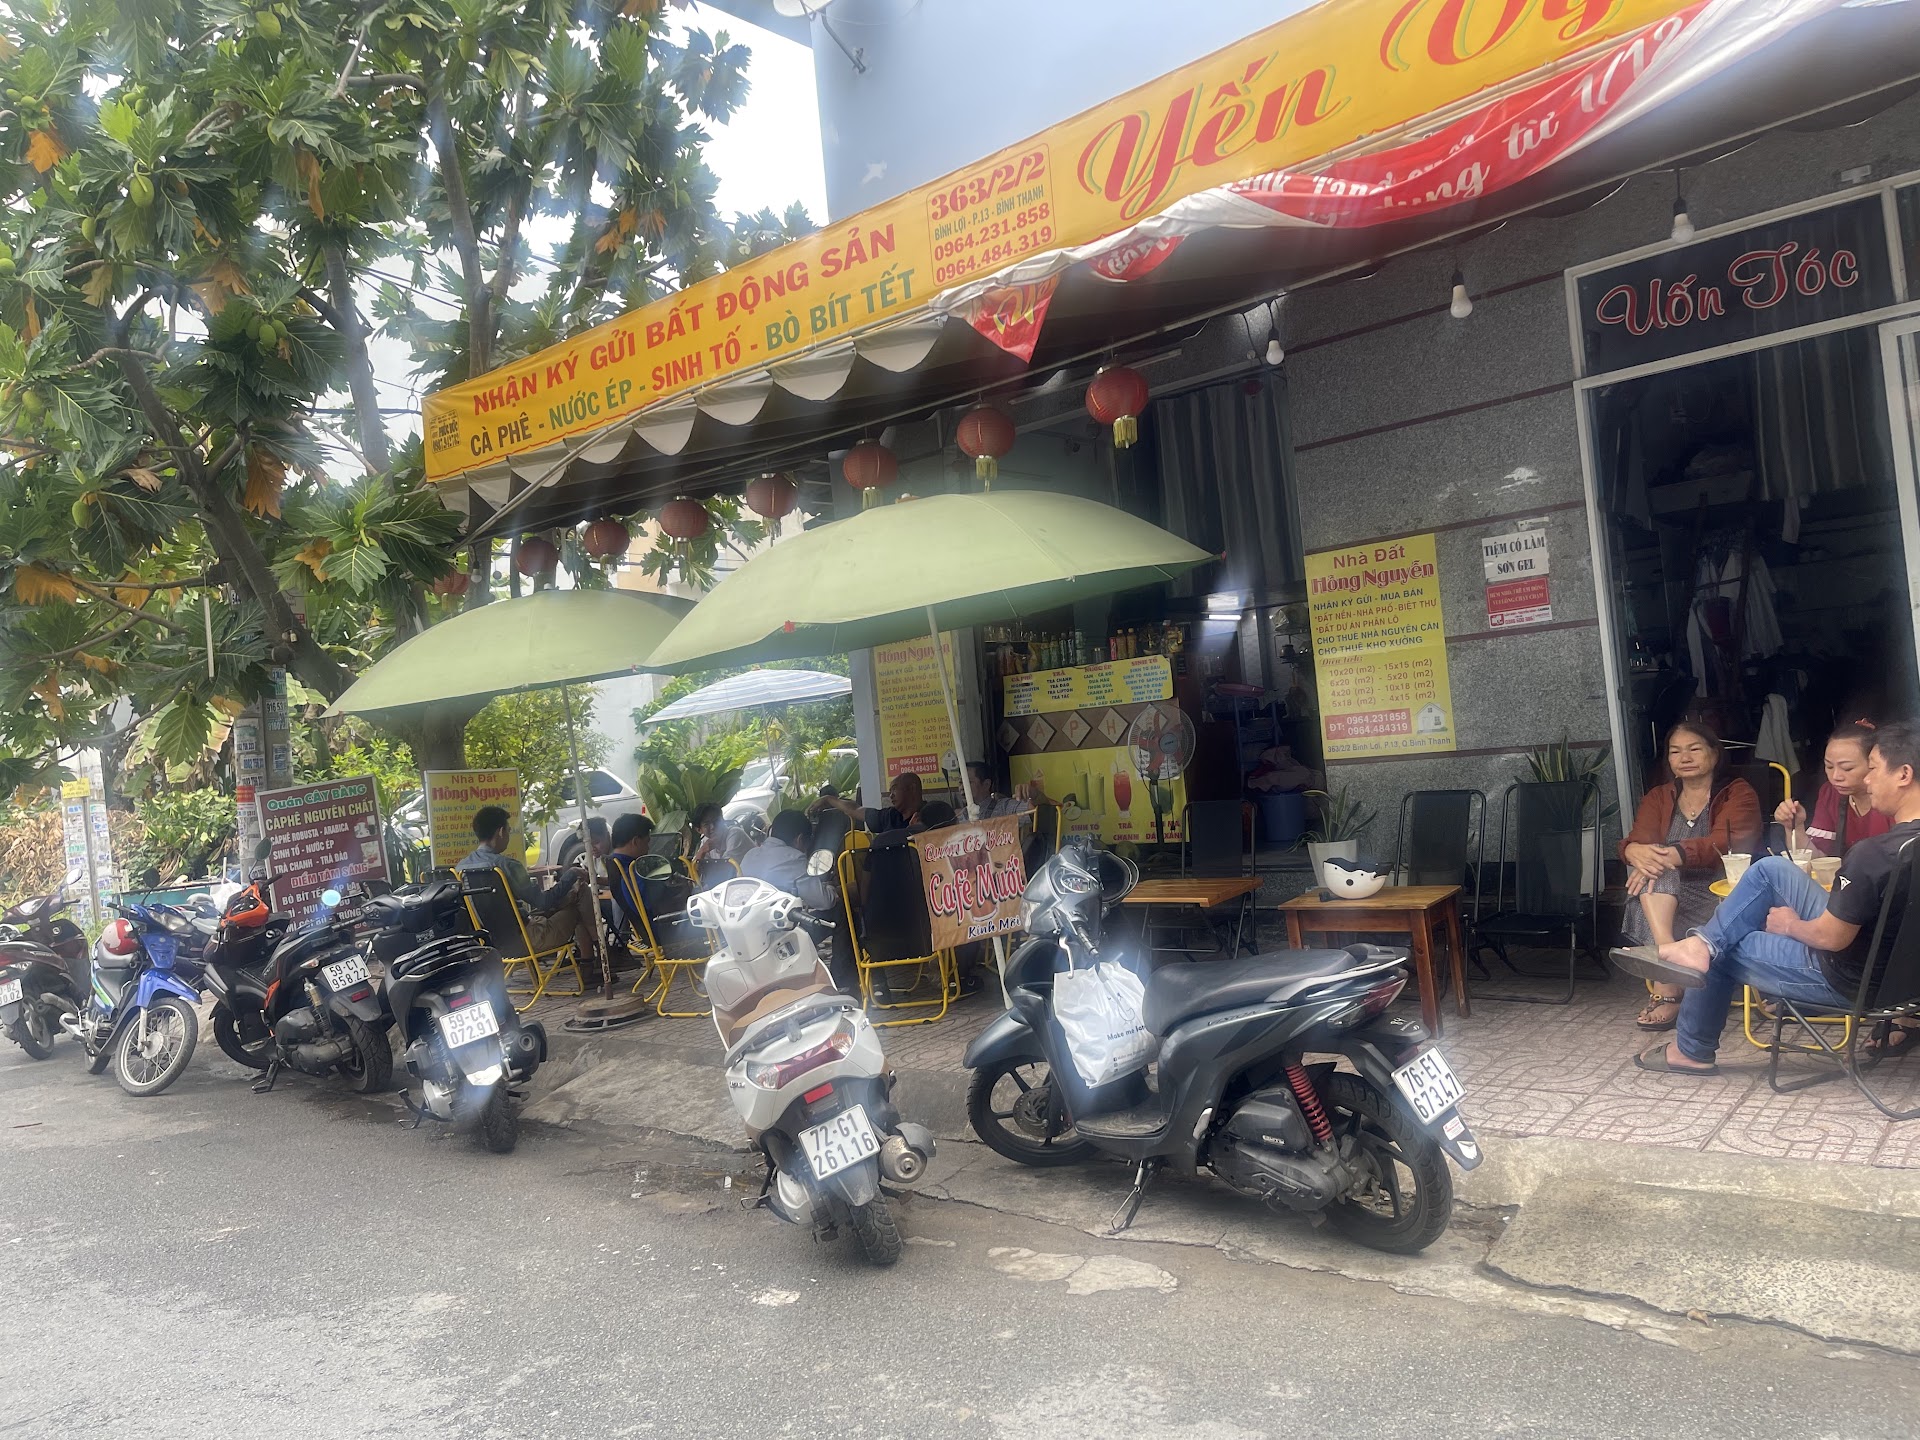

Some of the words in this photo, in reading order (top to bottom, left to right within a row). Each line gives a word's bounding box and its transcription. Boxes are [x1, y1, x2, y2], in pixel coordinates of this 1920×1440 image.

[1077, 50, 1351, 220] Yến
[1502, 111, 1560, 160] từ
[931, 152, 1046, 221] 363/2/2
[934, 222, 952, 241] BÌNH
[953, 216, 967, 236] LỢI
[973, 207, 990, 226] P.13
[996, 195, 1015, 216] BÌNH
[1017, 184, 1044, 208] THẠNH
[934, 202, 1050, 261] 0964.231.858
[936, 225, 1052, 283] 0964.484.319
[1596, 274, 1726, 336] Uốn
[1727, 241, 1859, 309] Tóc
[473, 375, 537, 416] NHẬN
[546, 351, 579, 388] KÝ
[590, 329, 636, 371] GỬI
[646, 300, 704, 350] BẤT
[716, 262, 810, 320] ĐỘNG
[820, 224, 896, 278] SẢN
[470, 423, 493, 457] CÀ
[498, 412, 532, 448] PHÊ
[548, 389, 600, 430] NƯỚC
[605, 377, 632, 410] ÉP
[651, 351, 703, 391] SINH
[710, 325, 742, 366] TỐ
[765, 309, 800, 351] BÒ
[810, 292, 852, 334] BÍT
[860, 263, 915, 314] TẾT
[1333, 552, 1369, 569] Nhà
[1374, 544, 1406, 562] Đất
[1484, 542, 1508, 558] TIỆM
[1509, 538, 1522, 553] CÓ
[1524, 535, 1545, 550] LÀM
[1311, 575, 1361, 595] Hồng
[1362, 560, 1435, 588] Nguyễn
[1497, 561, 1515, 575] SƠN
[1517, 559, 1535, 572] GEL
[1341, 598, 1353, 607] KÝ
[1380, 590, 1401, 601] MUA
[1403, 588, 1424, 598] BÁN
[1317, 635, 1335, 645] CHO
[1336, 631, 1359, 642] THUÊ
[1361, 629, 1379, 640] NHÀ
[1381, 623, 1418, 637] NGUYÊN
[907, 643, 950, 661] Nguyn
[1318, 648, 1337, 656] CHO
[1339, 642, 1363, 654] THUÊ
[1366, 641, 1387, 650] KHO
[1329, 667, 1354, 677] 10x20
[1356, 665, 1376, 674] (m2)
[1384, 661, 1410, 671] 15x15
[1412, 659, 1433, 668] (m2)
[1330, 678, 1350, 687] 6x20
[1354, 676, 1374, 685] (m2)
[1387, 672, 1408, 681] 5x20
[1413, 670, 1434, 679] (m2)
[1331, 688, 1351, 697] 4x20
[1354, 687, 1374, 696] (m2)
[1385, 683, 1411, 692] 10x18
[1414, 681, 1435, 689] (m2)
[1332, 699, 1352, 708] 5x18
[1356, 697, 1376, 706] (m2)
[1389, 694, 1410, 702] 4x15
[1415, 691, 1436, 700] (m2)
[1329, 722, 1345, 732] ĐT:
[1346, 711, 1407, 724] 0964.231858
[1347, 723, 1408, 736] 0964.484319
[451, 774, 474, 784] Nhà
[478, 772, 497, 783] Đất
[267, 795, 303, 811] Quán
[304, 790, 331, 805] CÂY
[331, 783, 367, 799] BÀNG
[431, 786, 468, 802] Hồng
[265, 811, 303, 832] CÀPHÊ
[304, 804, 346, 825] NGUYÊN
[348, 797, 375, 817] CHẤT
[291, 827, 319, 842] ROBUSTA
[324, 822, 350, 836] ARABICA
[272, 848, 290, 860] SINH
[291, 843, 301, 856] TỐ
[325, 839, 335, 850] ÉP
[274, 863, 289, 875] TRÀ
[289, 858, 313, 872] CHANH
[320, 854, 334, 866] TRÀ
[334, 851, 349, 863] ĐÀO
[290, 869, 318, 889] ĐIỂM
[318, 867, 341, 882] TÂM
[341, 861, 369, 878] SÁNG
[282, 893, 295, 906] BÒ
[295, 890, 310, 903] BÍT
[311, 884, 326, 899] TẾT
[930, 868, 974, 926] Café
[976, 854, 1025, 908] Muối
[303, 903, 318, 915] NUI
[329, 958, 359, 977] 59-C1
[332, 967, 369, 990] 958.22
[449, 1005, 486, 1030] 59-C4
[449, 1018, 495, 1046] 072.91
[1107, 1031, 1124, 1041] Make
[1401, 1054, 1442, 1094] 76-E1
[1413, 1073, 1459, 1119] 673.47
[810, 1112, 859, 1151] 72-G1
[814, 1131, 875, 1177] 261.16
